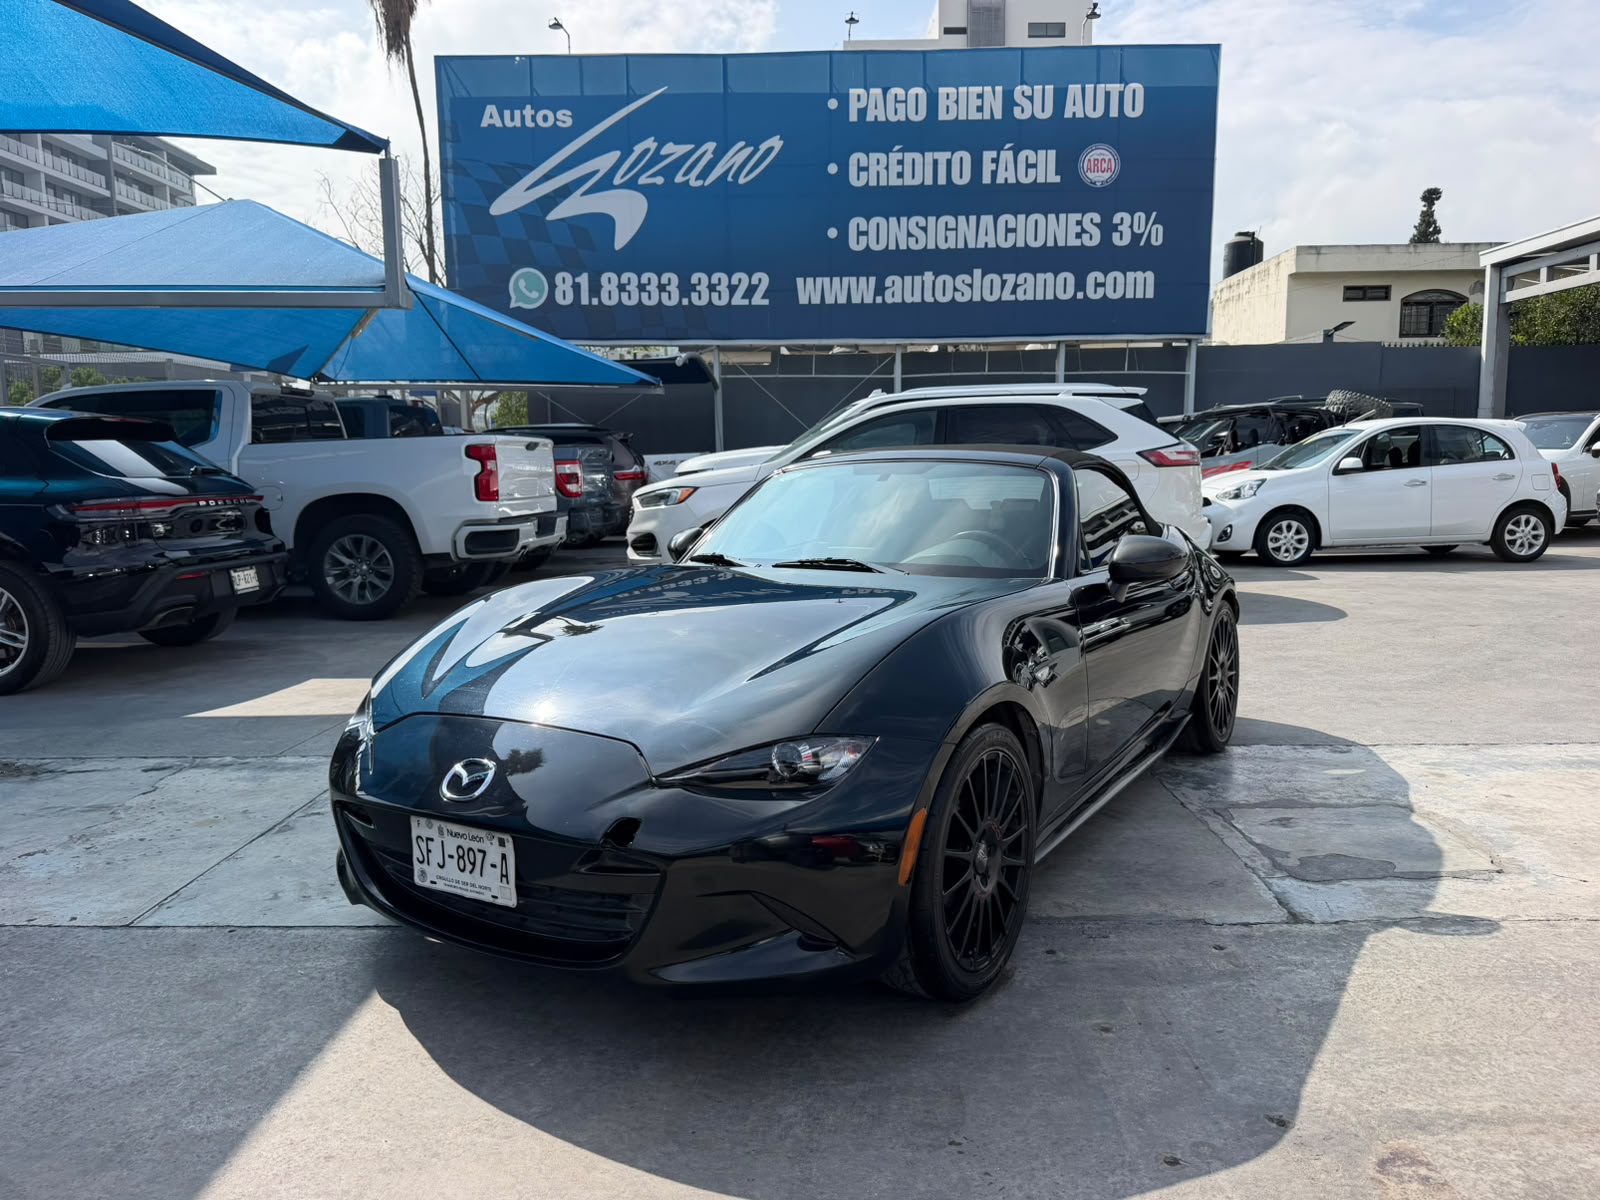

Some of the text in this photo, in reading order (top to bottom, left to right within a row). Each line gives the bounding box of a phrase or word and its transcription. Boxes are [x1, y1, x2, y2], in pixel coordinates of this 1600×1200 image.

[480, 104, 573, 128] Autos
[848, 83, 1145, 122] PAGO BIEN SU AUTO
[848, 143, 1061, 187] CRÉDITO FÁCIL
[1086, 157, 1113, 174] ARCA
[848, 211, 1164, 251] CONSIGNACIONES 3%
[554, 271, 770, 306] 81.8333.3322
[796, 268, 1155, 305] www.autoslozano.com
[446, 828, 485, 844] Nuevo León
[416, 835, 510, 885] SFJ-897-A
